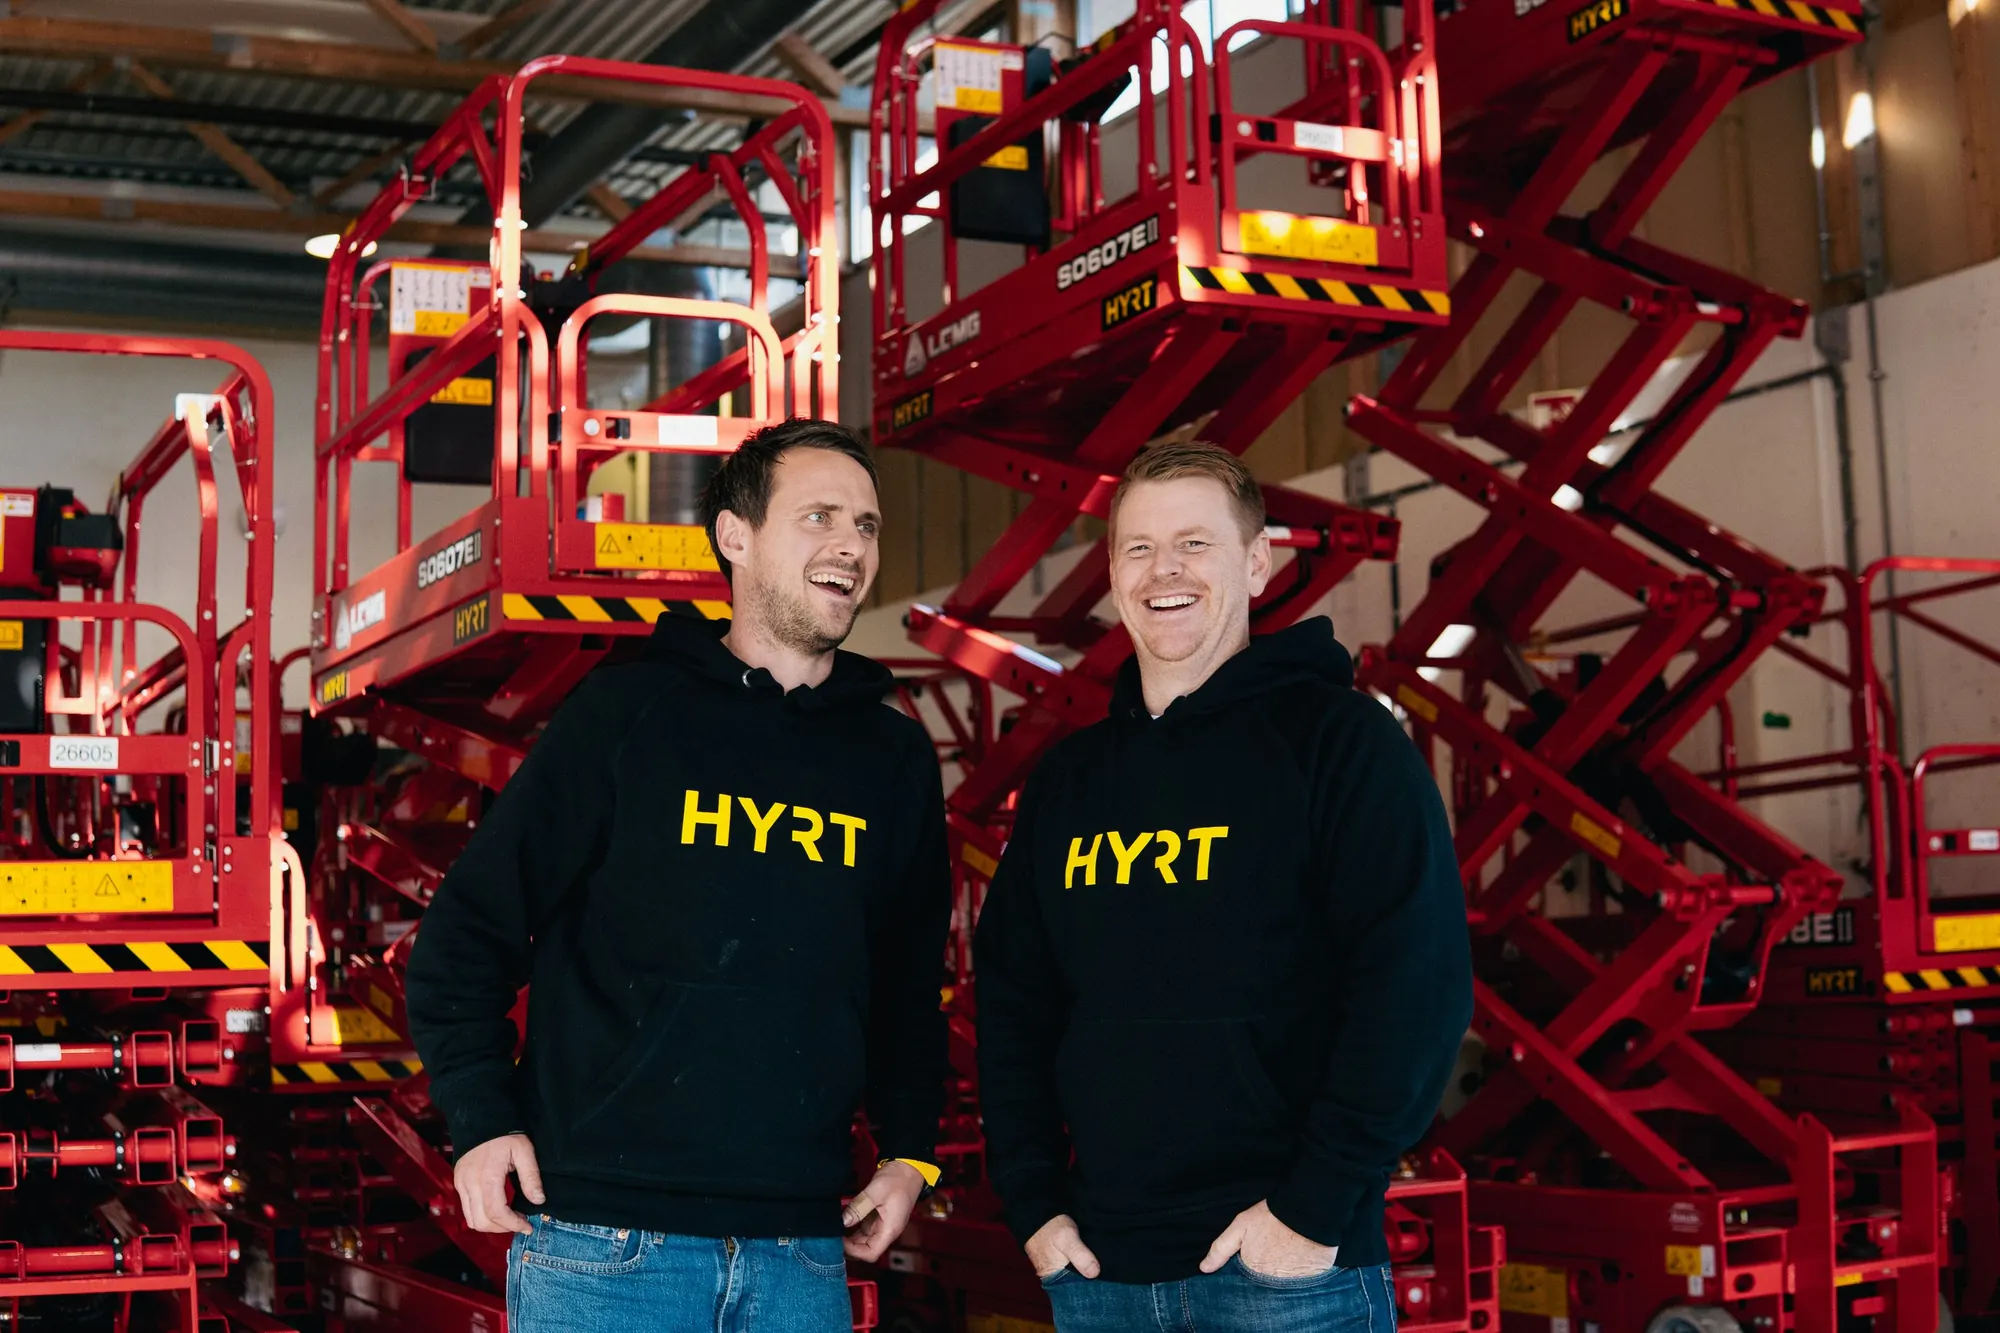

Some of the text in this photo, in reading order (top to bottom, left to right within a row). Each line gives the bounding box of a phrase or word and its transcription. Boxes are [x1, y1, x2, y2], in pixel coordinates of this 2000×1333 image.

[1105, 280, 1154, 326] HYRT
[894, 392, 931, 427] HYRT
[455, 600, 488, 640] HYRT
[55, 743, 113, 763] 26605
[680, 789, 867, 868] HYRT
[1064, 825, 1230, 889] HYRT
[1808, 969, 1857, 993] HYRT
